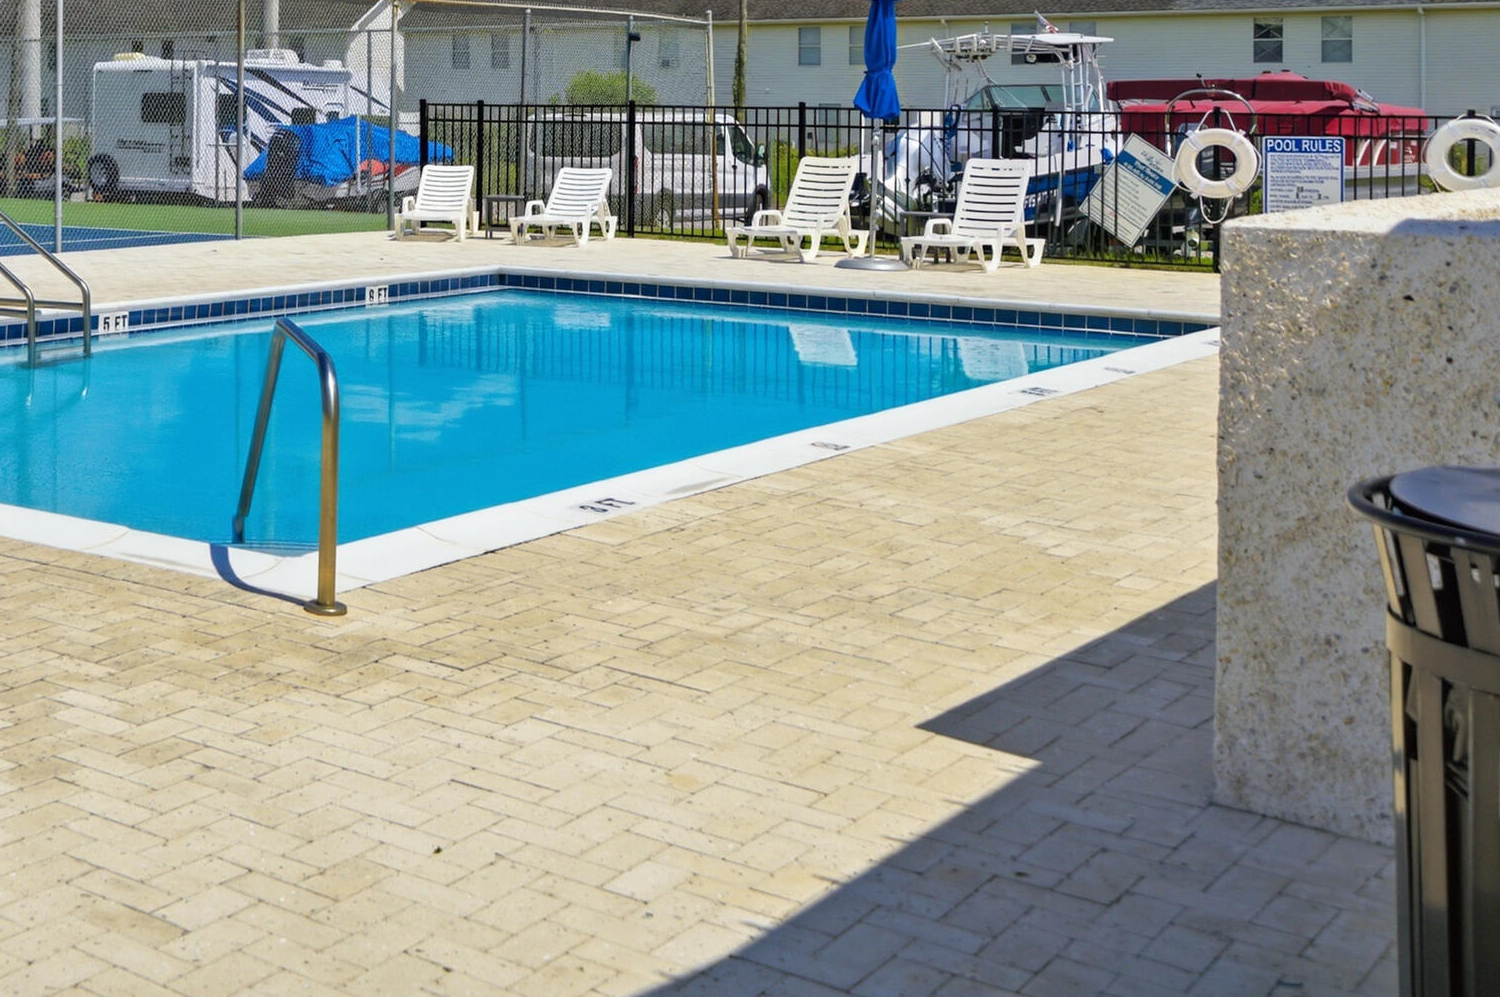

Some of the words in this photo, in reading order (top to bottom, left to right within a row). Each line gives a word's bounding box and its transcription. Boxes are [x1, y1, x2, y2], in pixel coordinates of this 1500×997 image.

[1267, 139, 1299, 151] POOL
[1302, 139, 1341, 152] RULES
[377, 287, 388, 300] FT
[103, 316, 110, 332] 5
[115, 314, 127, 329] FT
